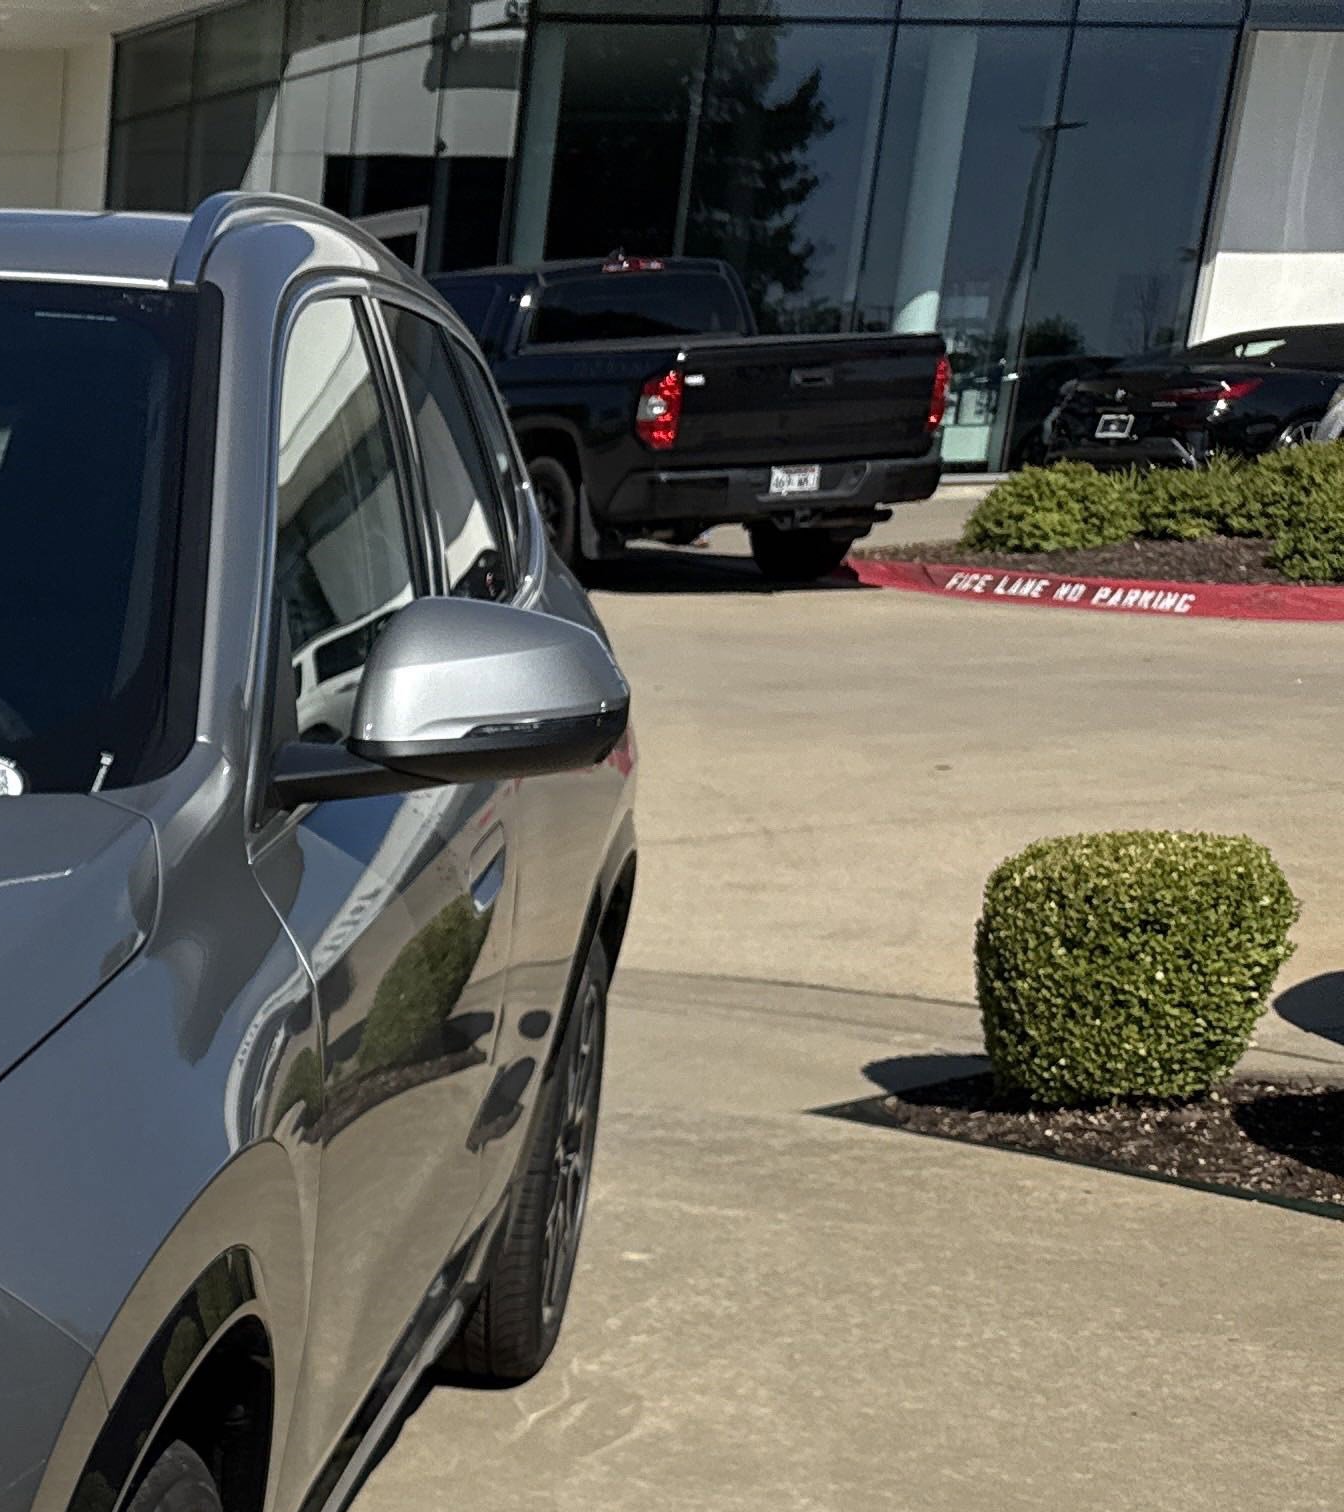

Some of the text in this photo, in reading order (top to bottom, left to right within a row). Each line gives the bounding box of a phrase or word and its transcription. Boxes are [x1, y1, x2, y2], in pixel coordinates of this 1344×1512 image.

[993, 575, 1050, 598] LANE
[1052, 582, 1087, 602] NO
[1090, 586, 1196, 613] PARKING
